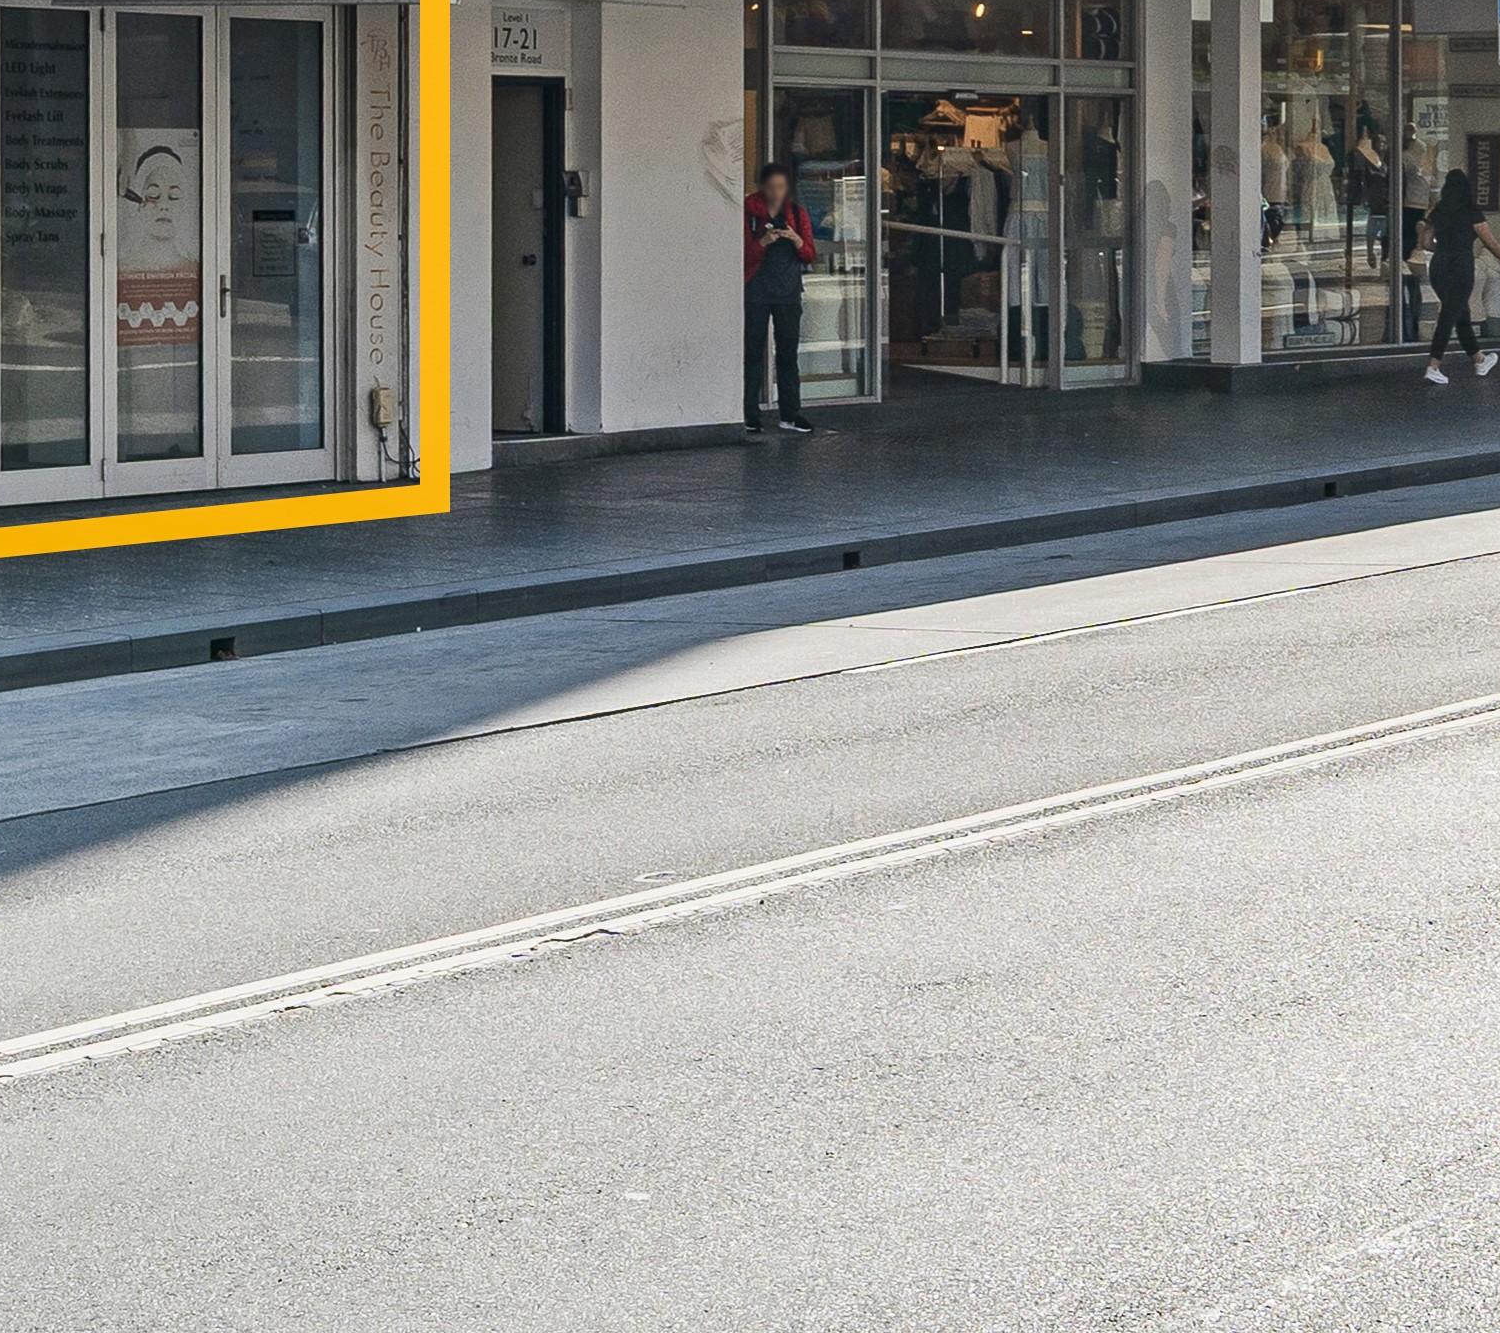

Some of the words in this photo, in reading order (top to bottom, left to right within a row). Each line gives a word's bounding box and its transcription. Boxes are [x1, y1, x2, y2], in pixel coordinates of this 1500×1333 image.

[494, 26, 537, 50] 17-21
[503, 13, 523, 23] Level
[520, 52, 542, 64] Road
[369, 86, 392, 142] The
[364, 150, 391, 258] Beauty
[369, 268, 391, 367] House
